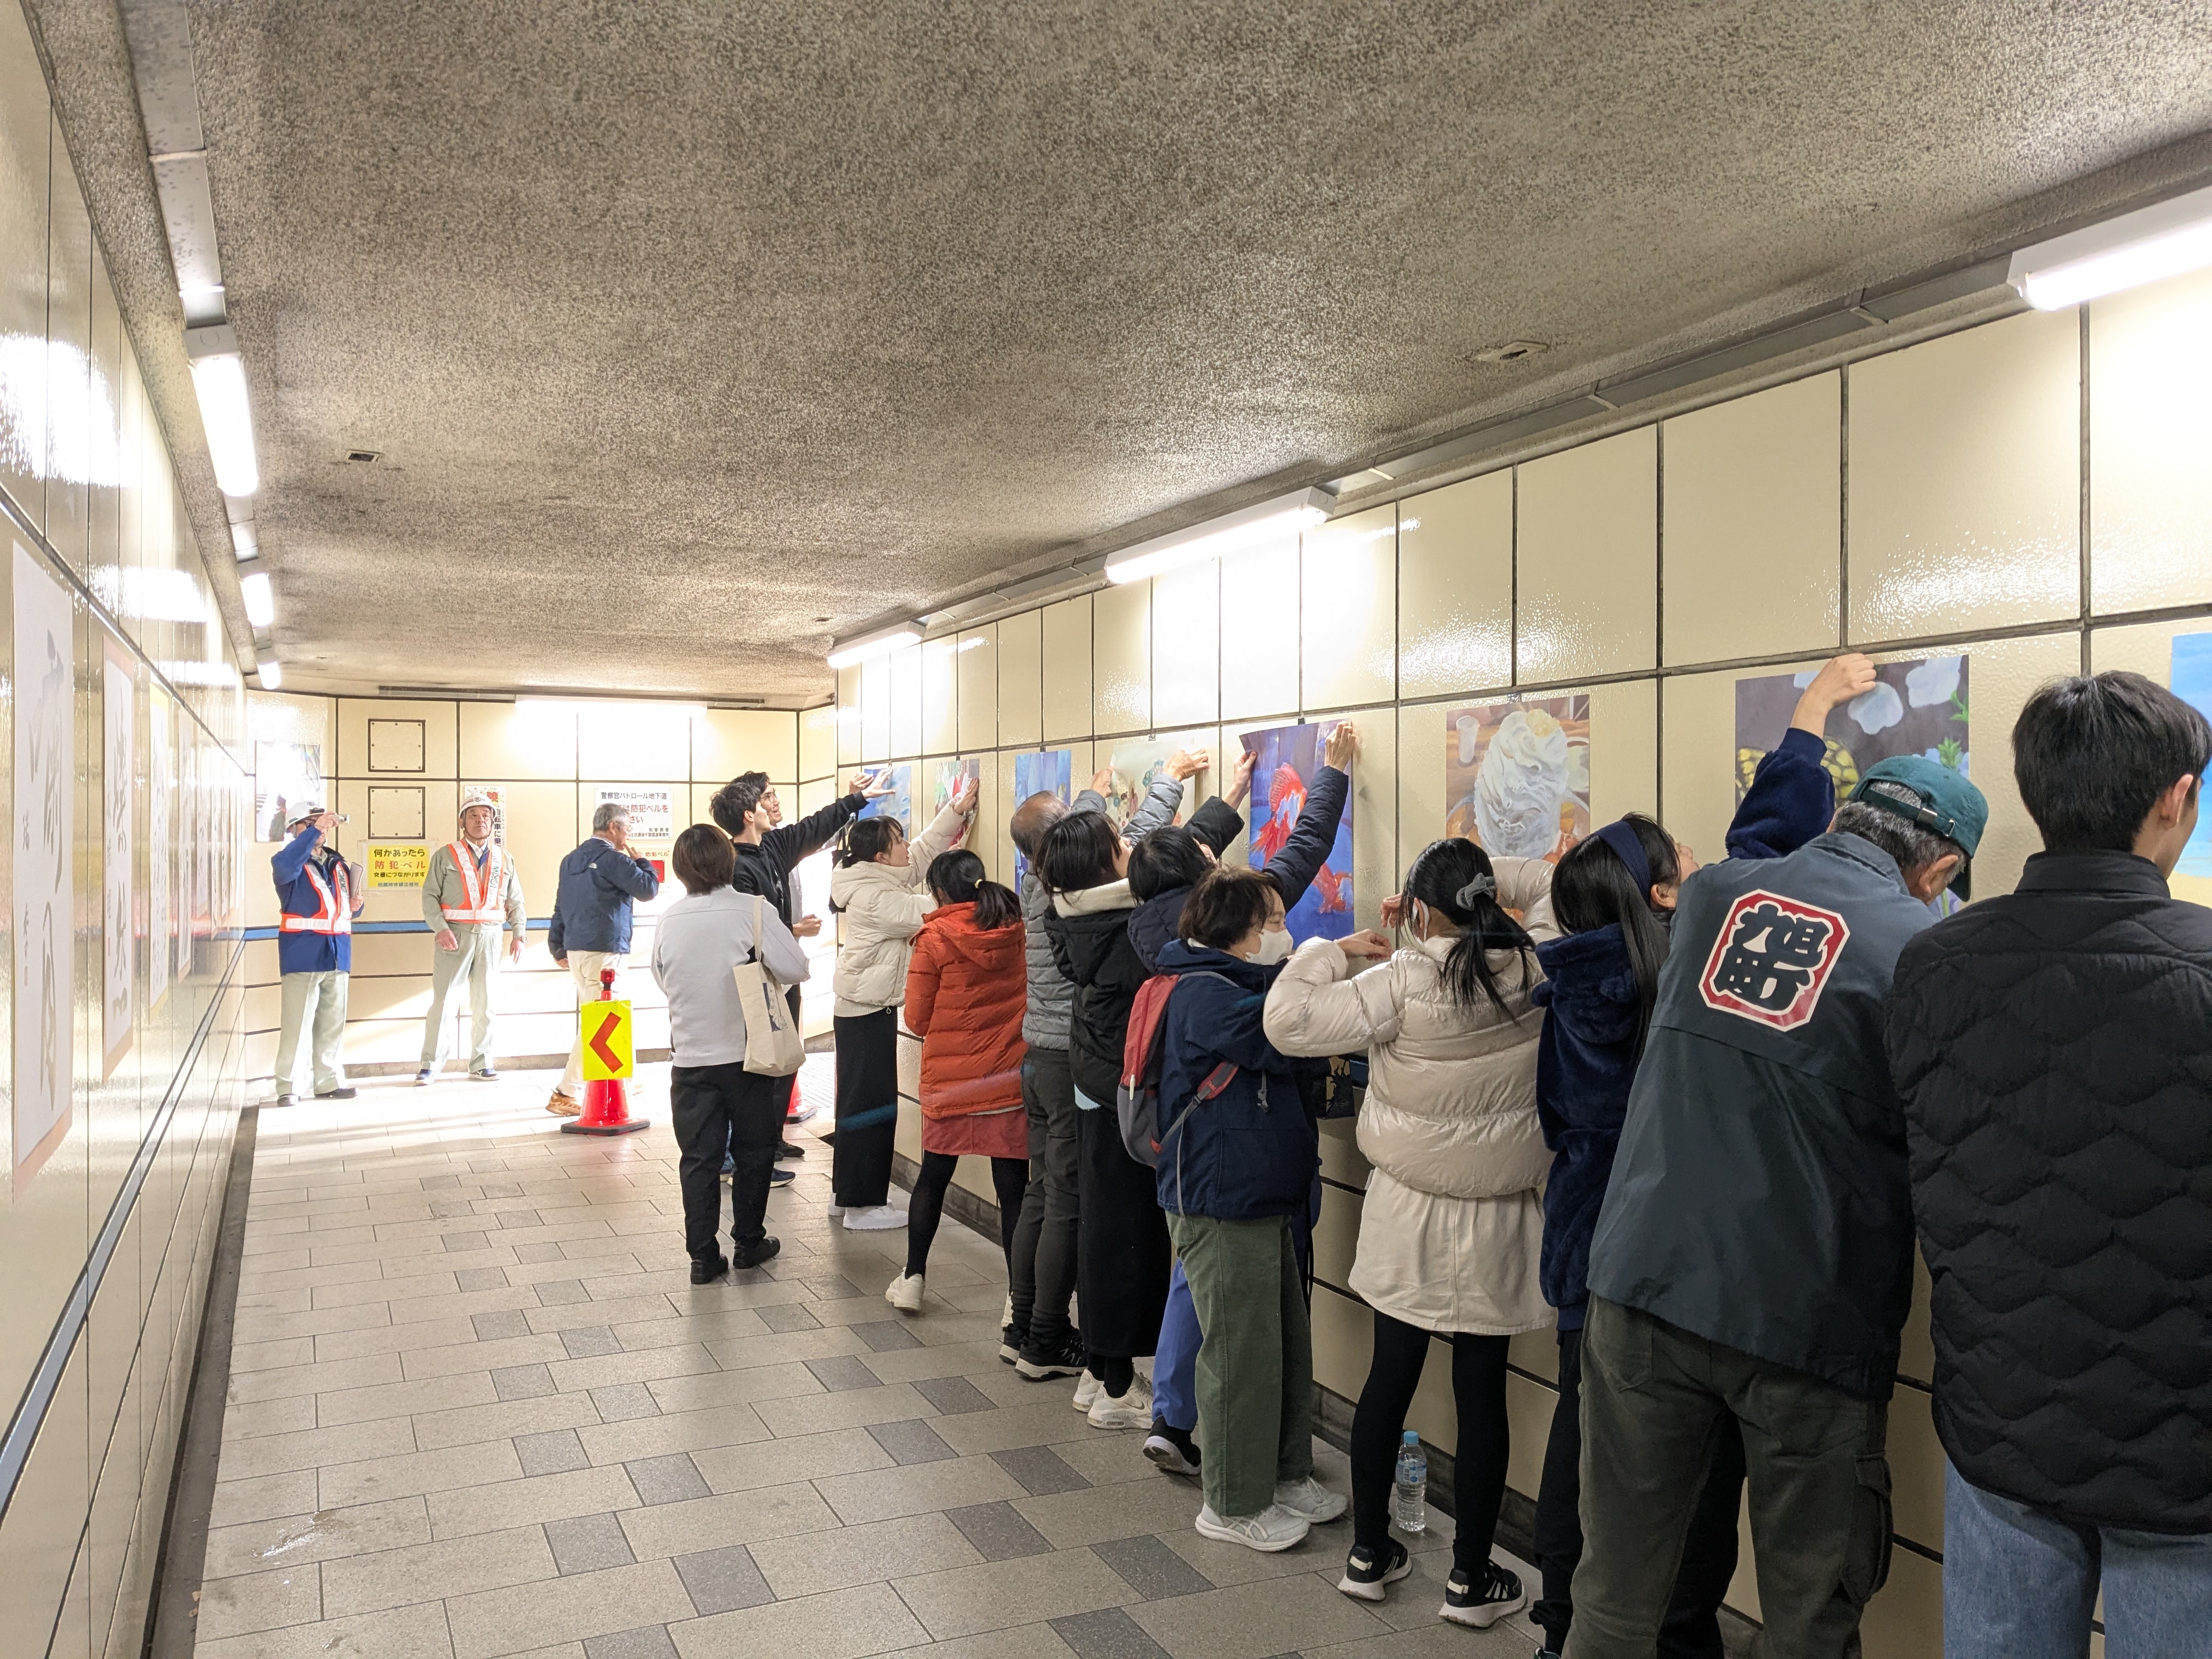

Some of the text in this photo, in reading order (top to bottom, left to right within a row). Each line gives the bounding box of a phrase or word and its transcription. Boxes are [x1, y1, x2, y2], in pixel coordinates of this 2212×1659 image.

[601, 792, 667, 800] 警察官パトロール地下道
[619, 804, 669, 813] は防犯ベルを
[374, 848, 425, 857] 何かあったら
[375, 860, 426, 870] 防犯ベル
